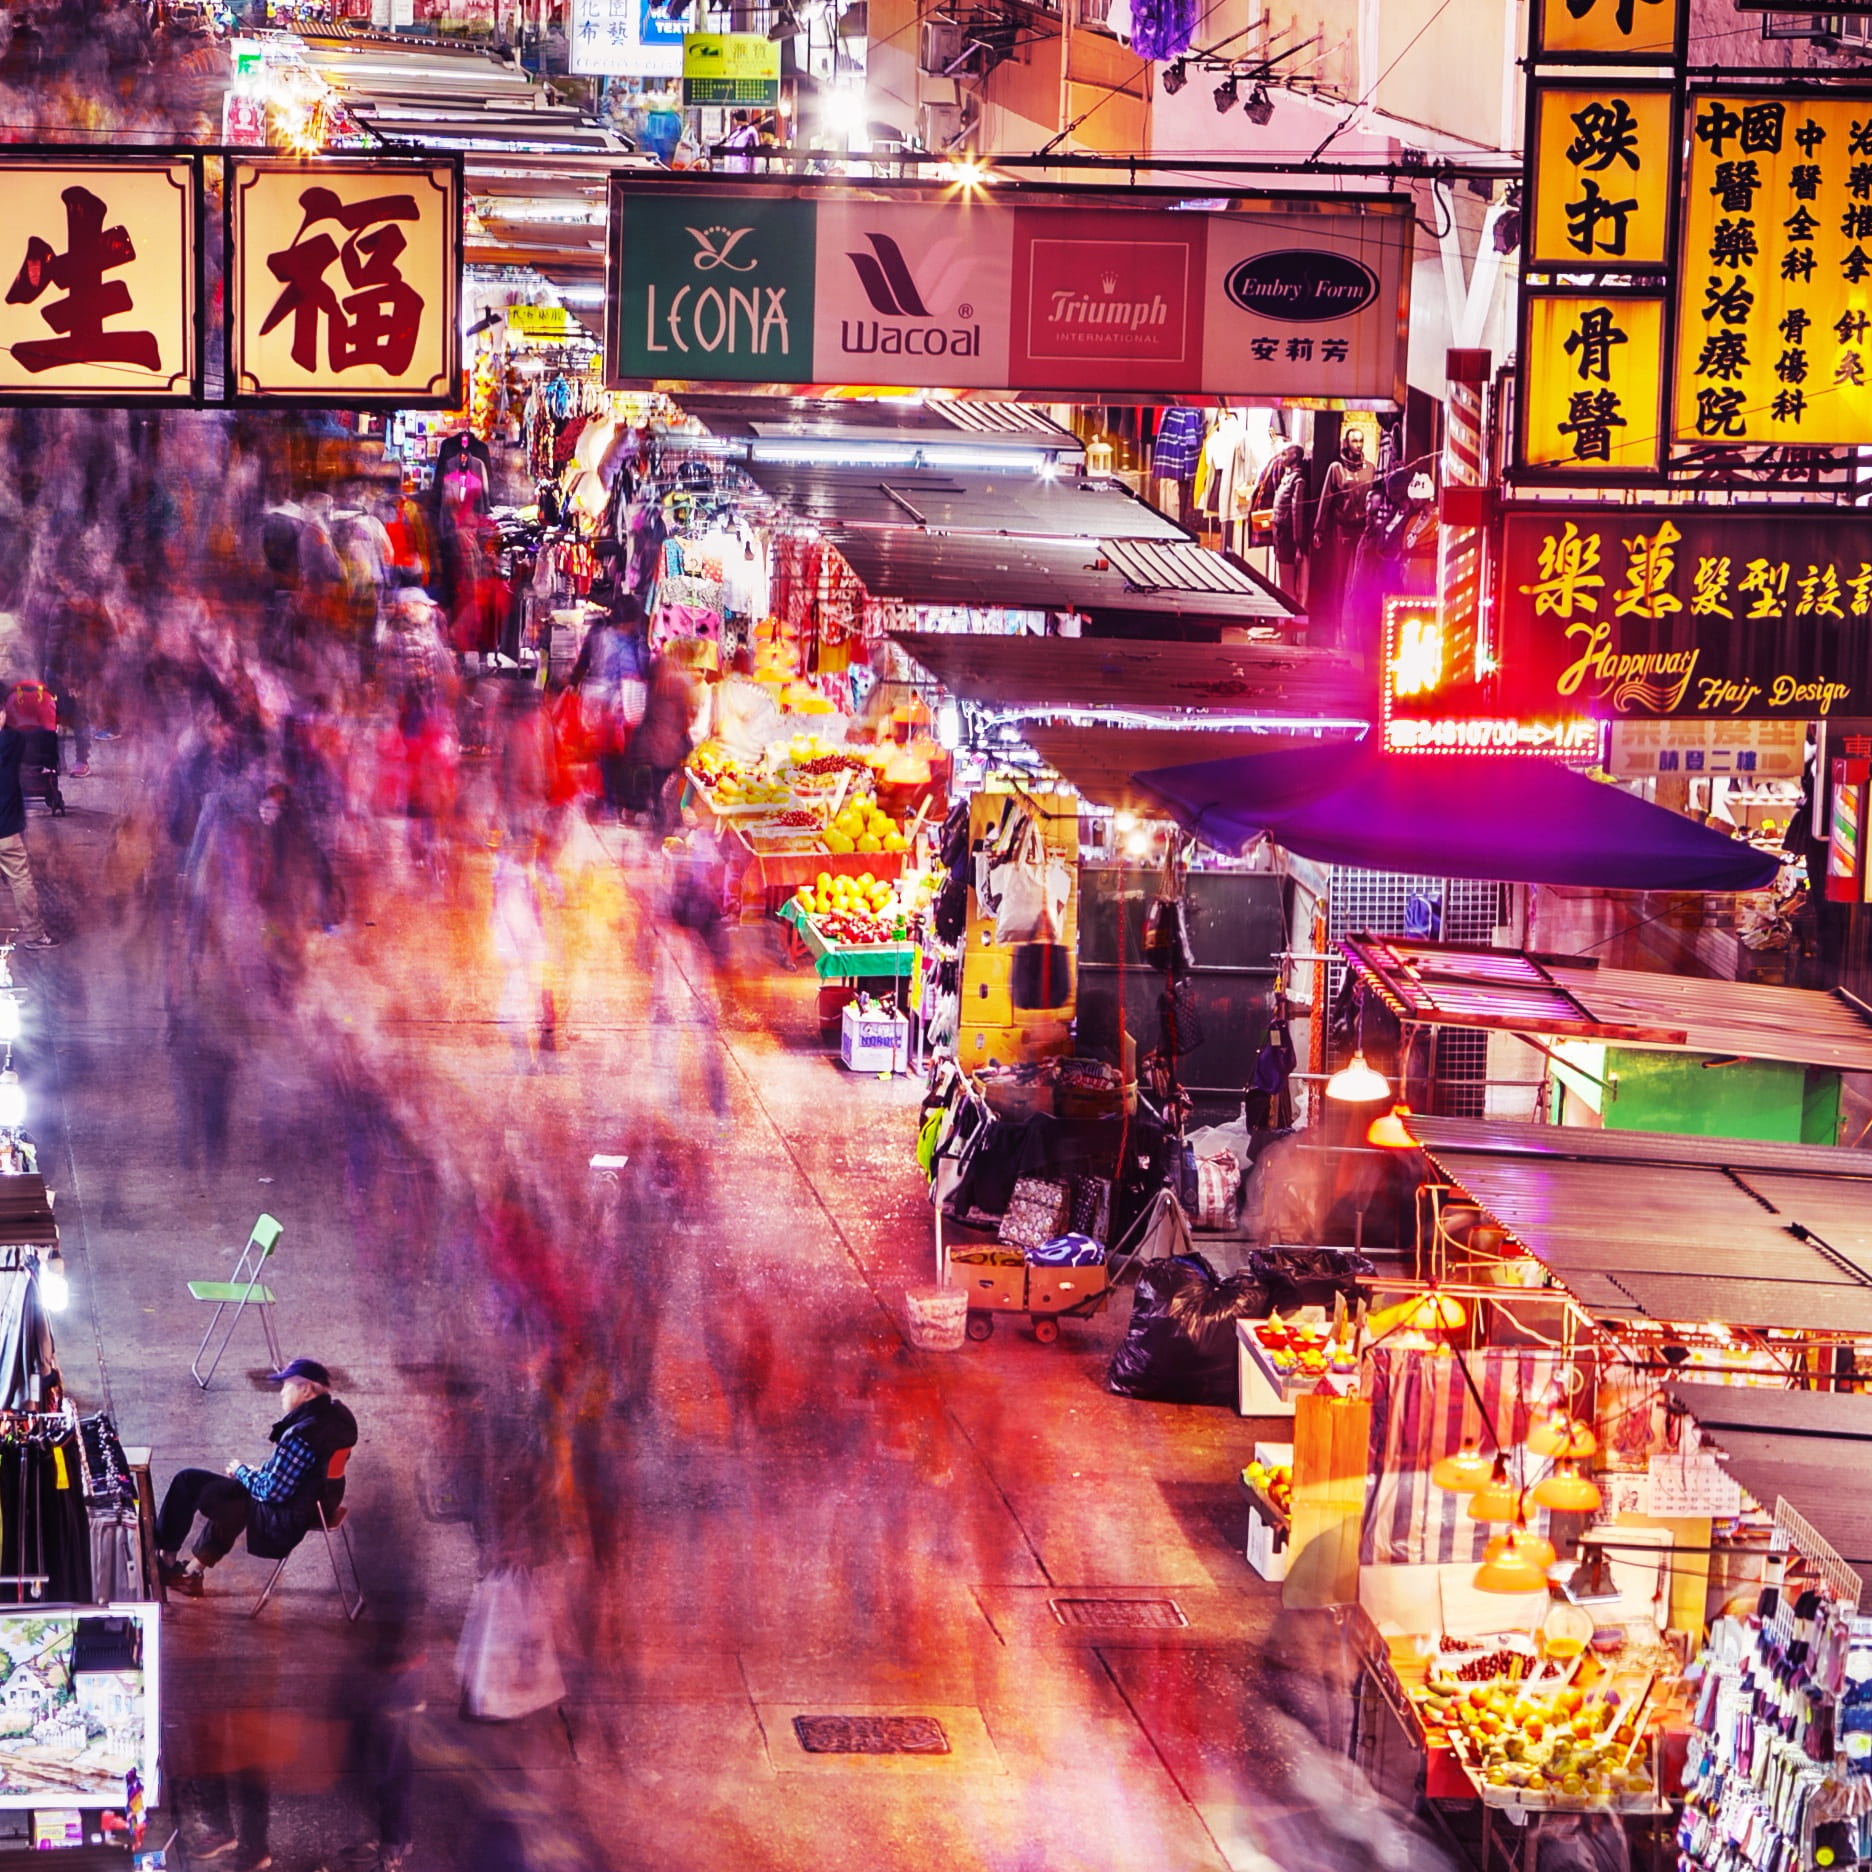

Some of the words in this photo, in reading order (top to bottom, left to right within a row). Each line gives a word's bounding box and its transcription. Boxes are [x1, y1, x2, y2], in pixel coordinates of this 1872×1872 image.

[1565, 100, 1640, 257] 跌打
[1780, 119, 1826, 285] 中醫全科
[1240, 275, 1303, 303] Embry
[1314, 276, 1367, 302] Form
[1695, 102, 1785, 438] 中國醫藥治療院
[647, 284, 790, 354] LEONA
[842, 320, 981, 358] Wacoal
[1048, 289, 1169, 331] Triumph
[1055, 331, 1161, 345] INTERNATIONAL
[1250, 337, 1350, 364] 安莉芳
[1771, 309, 1813, 426] 骨傷科
[1833, 309, 1871, 387] 針灸
[1558, 311, 1629, 462] 骨醫
[1557, 621, 1699, 698] Happyway
[1698, 677, 1760, 713] Hair
[1769, 676, 1850, 714] Design
